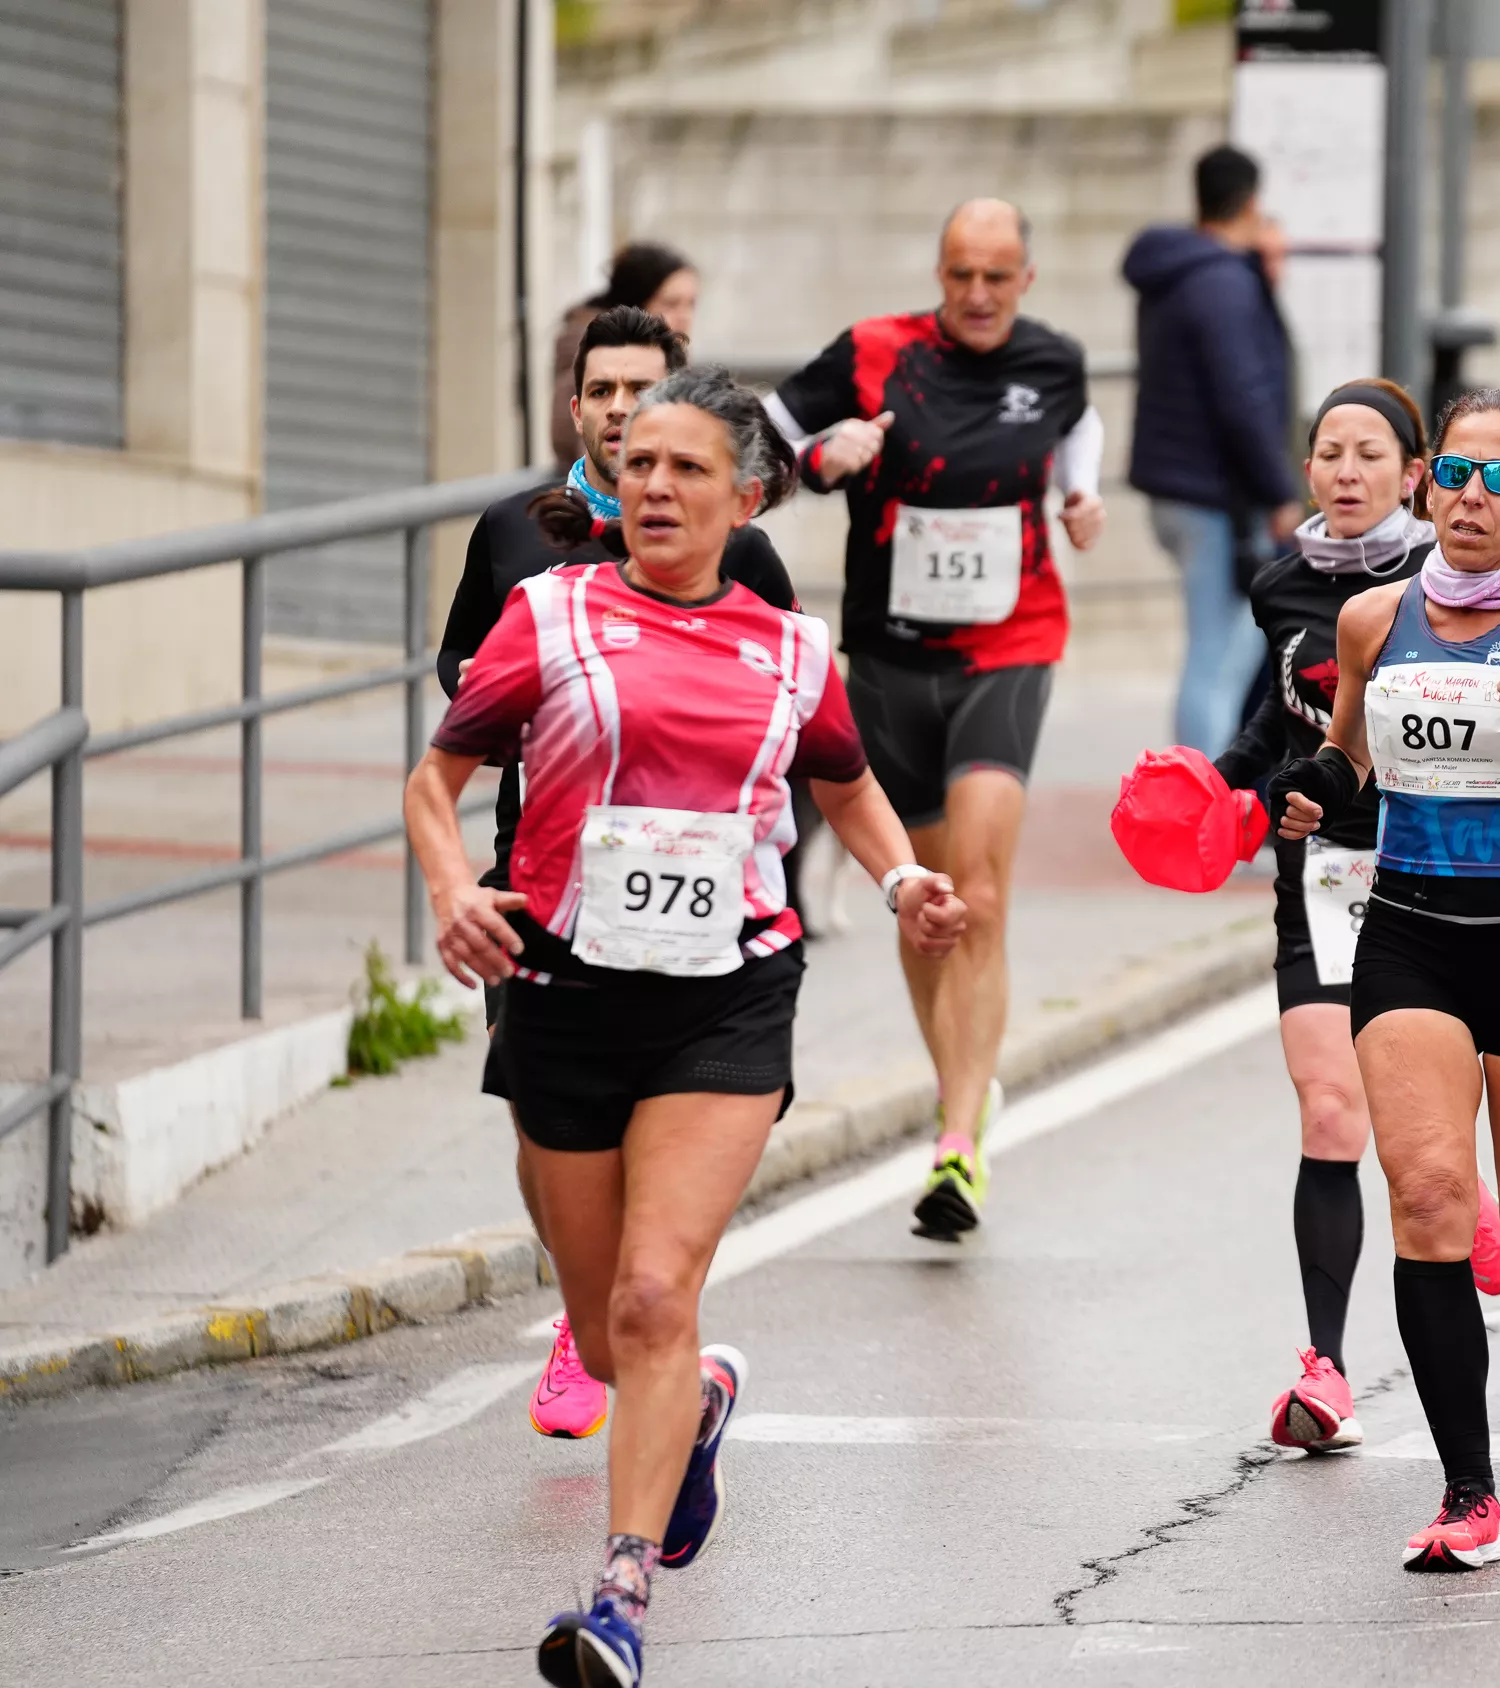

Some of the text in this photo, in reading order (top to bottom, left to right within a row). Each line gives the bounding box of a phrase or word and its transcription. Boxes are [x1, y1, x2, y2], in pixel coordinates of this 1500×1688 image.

[927, 552, 986, 580] 151
[1402, 714, 1476, 750] 807
[625, 870, 716, 918] 978
